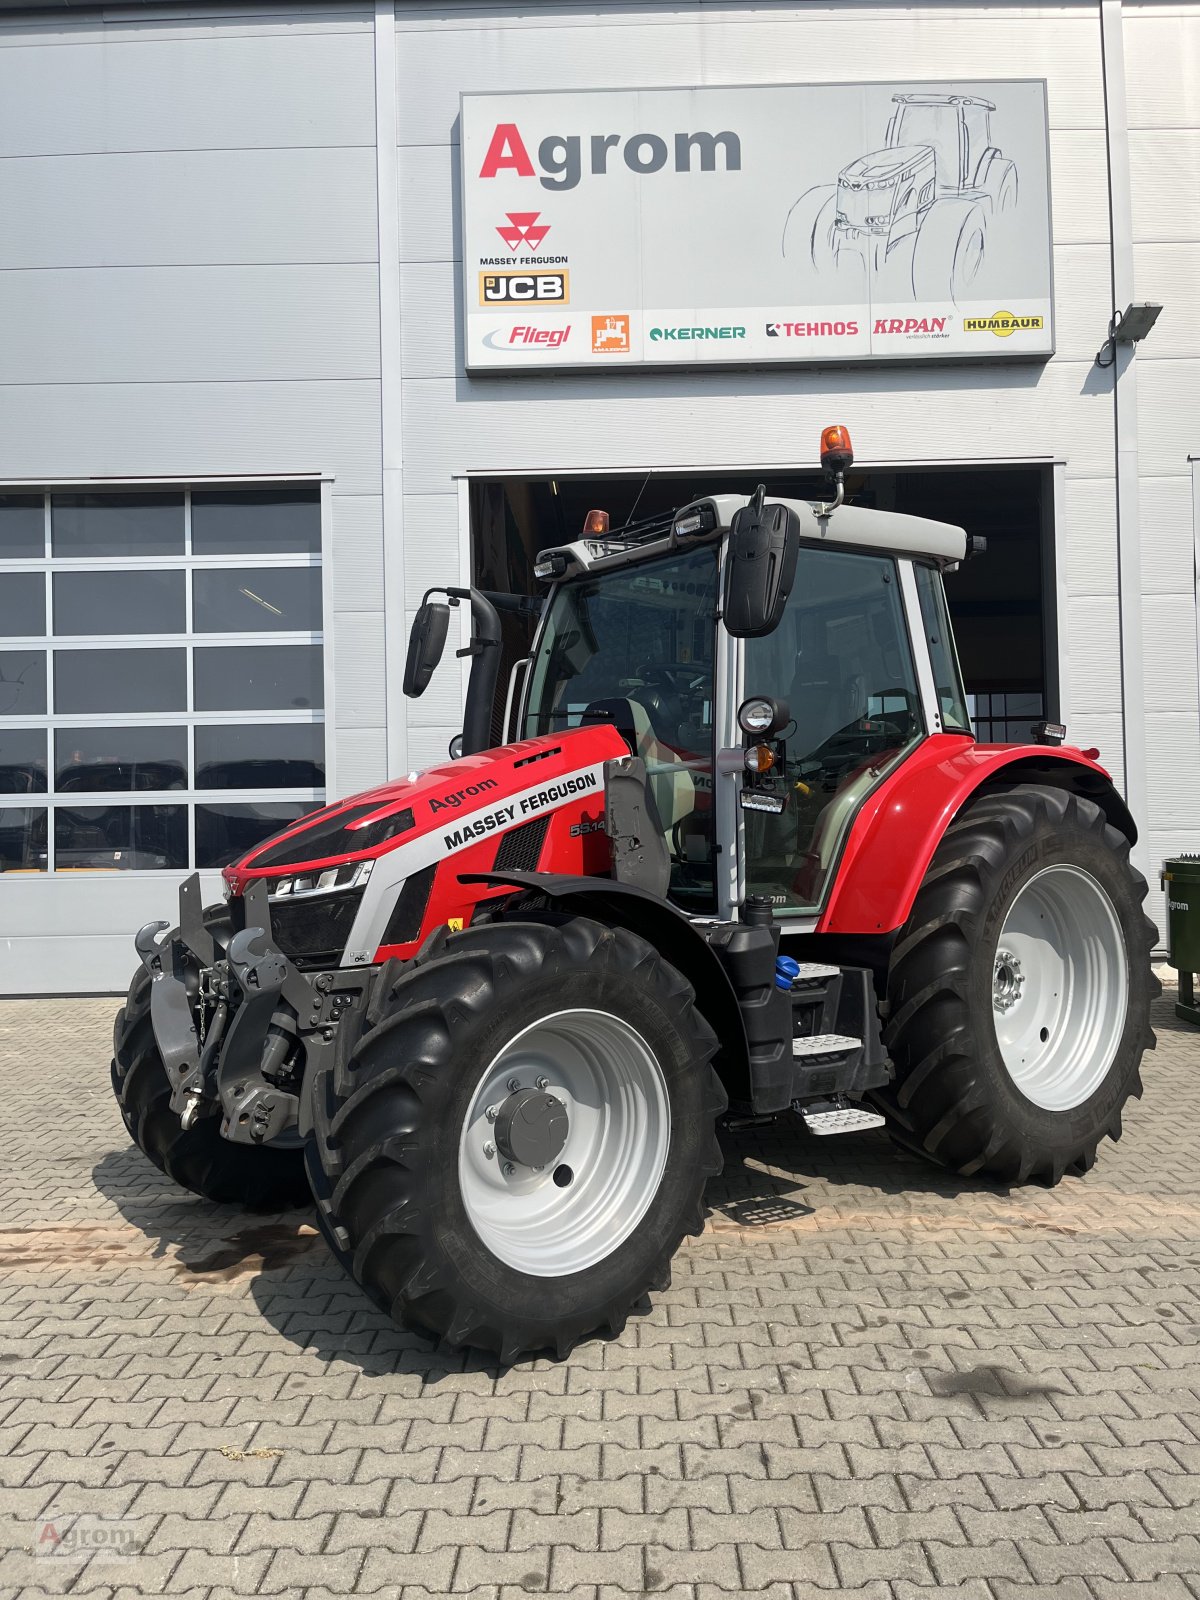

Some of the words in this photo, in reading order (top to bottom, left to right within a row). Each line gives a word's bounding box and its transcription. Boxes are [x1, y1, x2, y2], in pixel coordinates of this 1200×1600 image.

[479, 123, 742, 192] Agrom
[479, 257, 517, 265] MASSEY
[520, 256, 568, 264] FERGUSON
[486, 276, 563, 300] JCB
[664, 326, 746, 341] KERNER
[783, 321, 859, 337] TEHNOS
[967, 318, 1040, 329] HUMBAUR
[508, 325, 571, 347] Fliegl
[428, 777, 499, 814] Agrom
[443, 804, 516, 851] MASSEY
[519, 772, 597, 814] FERGUSON
